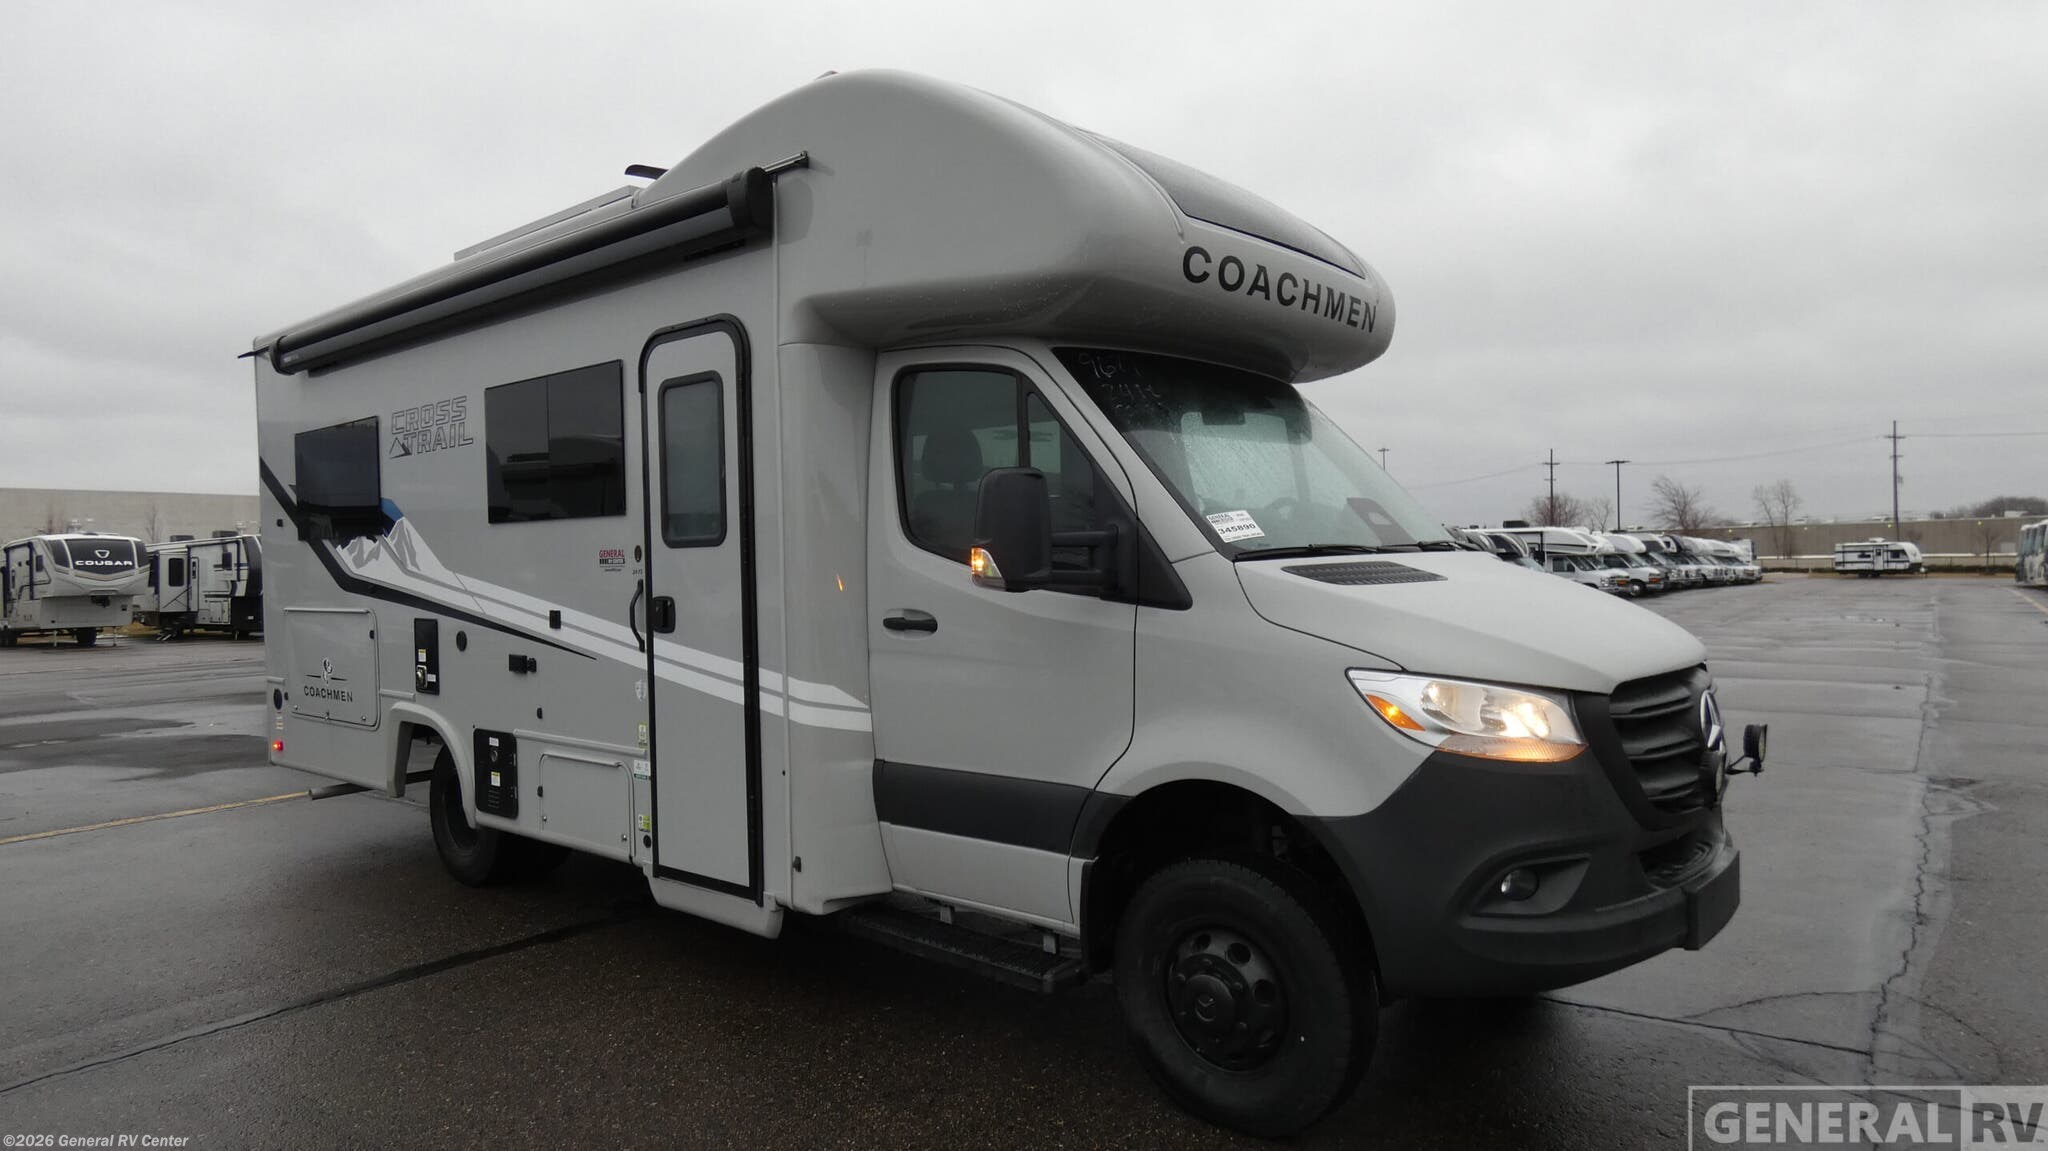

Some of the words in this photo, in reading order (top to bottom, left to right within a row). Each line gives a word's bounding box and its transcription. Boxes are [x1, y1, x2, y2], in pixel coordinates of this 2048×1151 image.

[1182, 246, 1377, 333] COACHMEN
[391, 395, 467, 435] CROSS
[403, 421, 474, 455] TRAIL
[599, 549, 625, 558] GENERAL
[303, 685, 353, 703] COACHMEN
